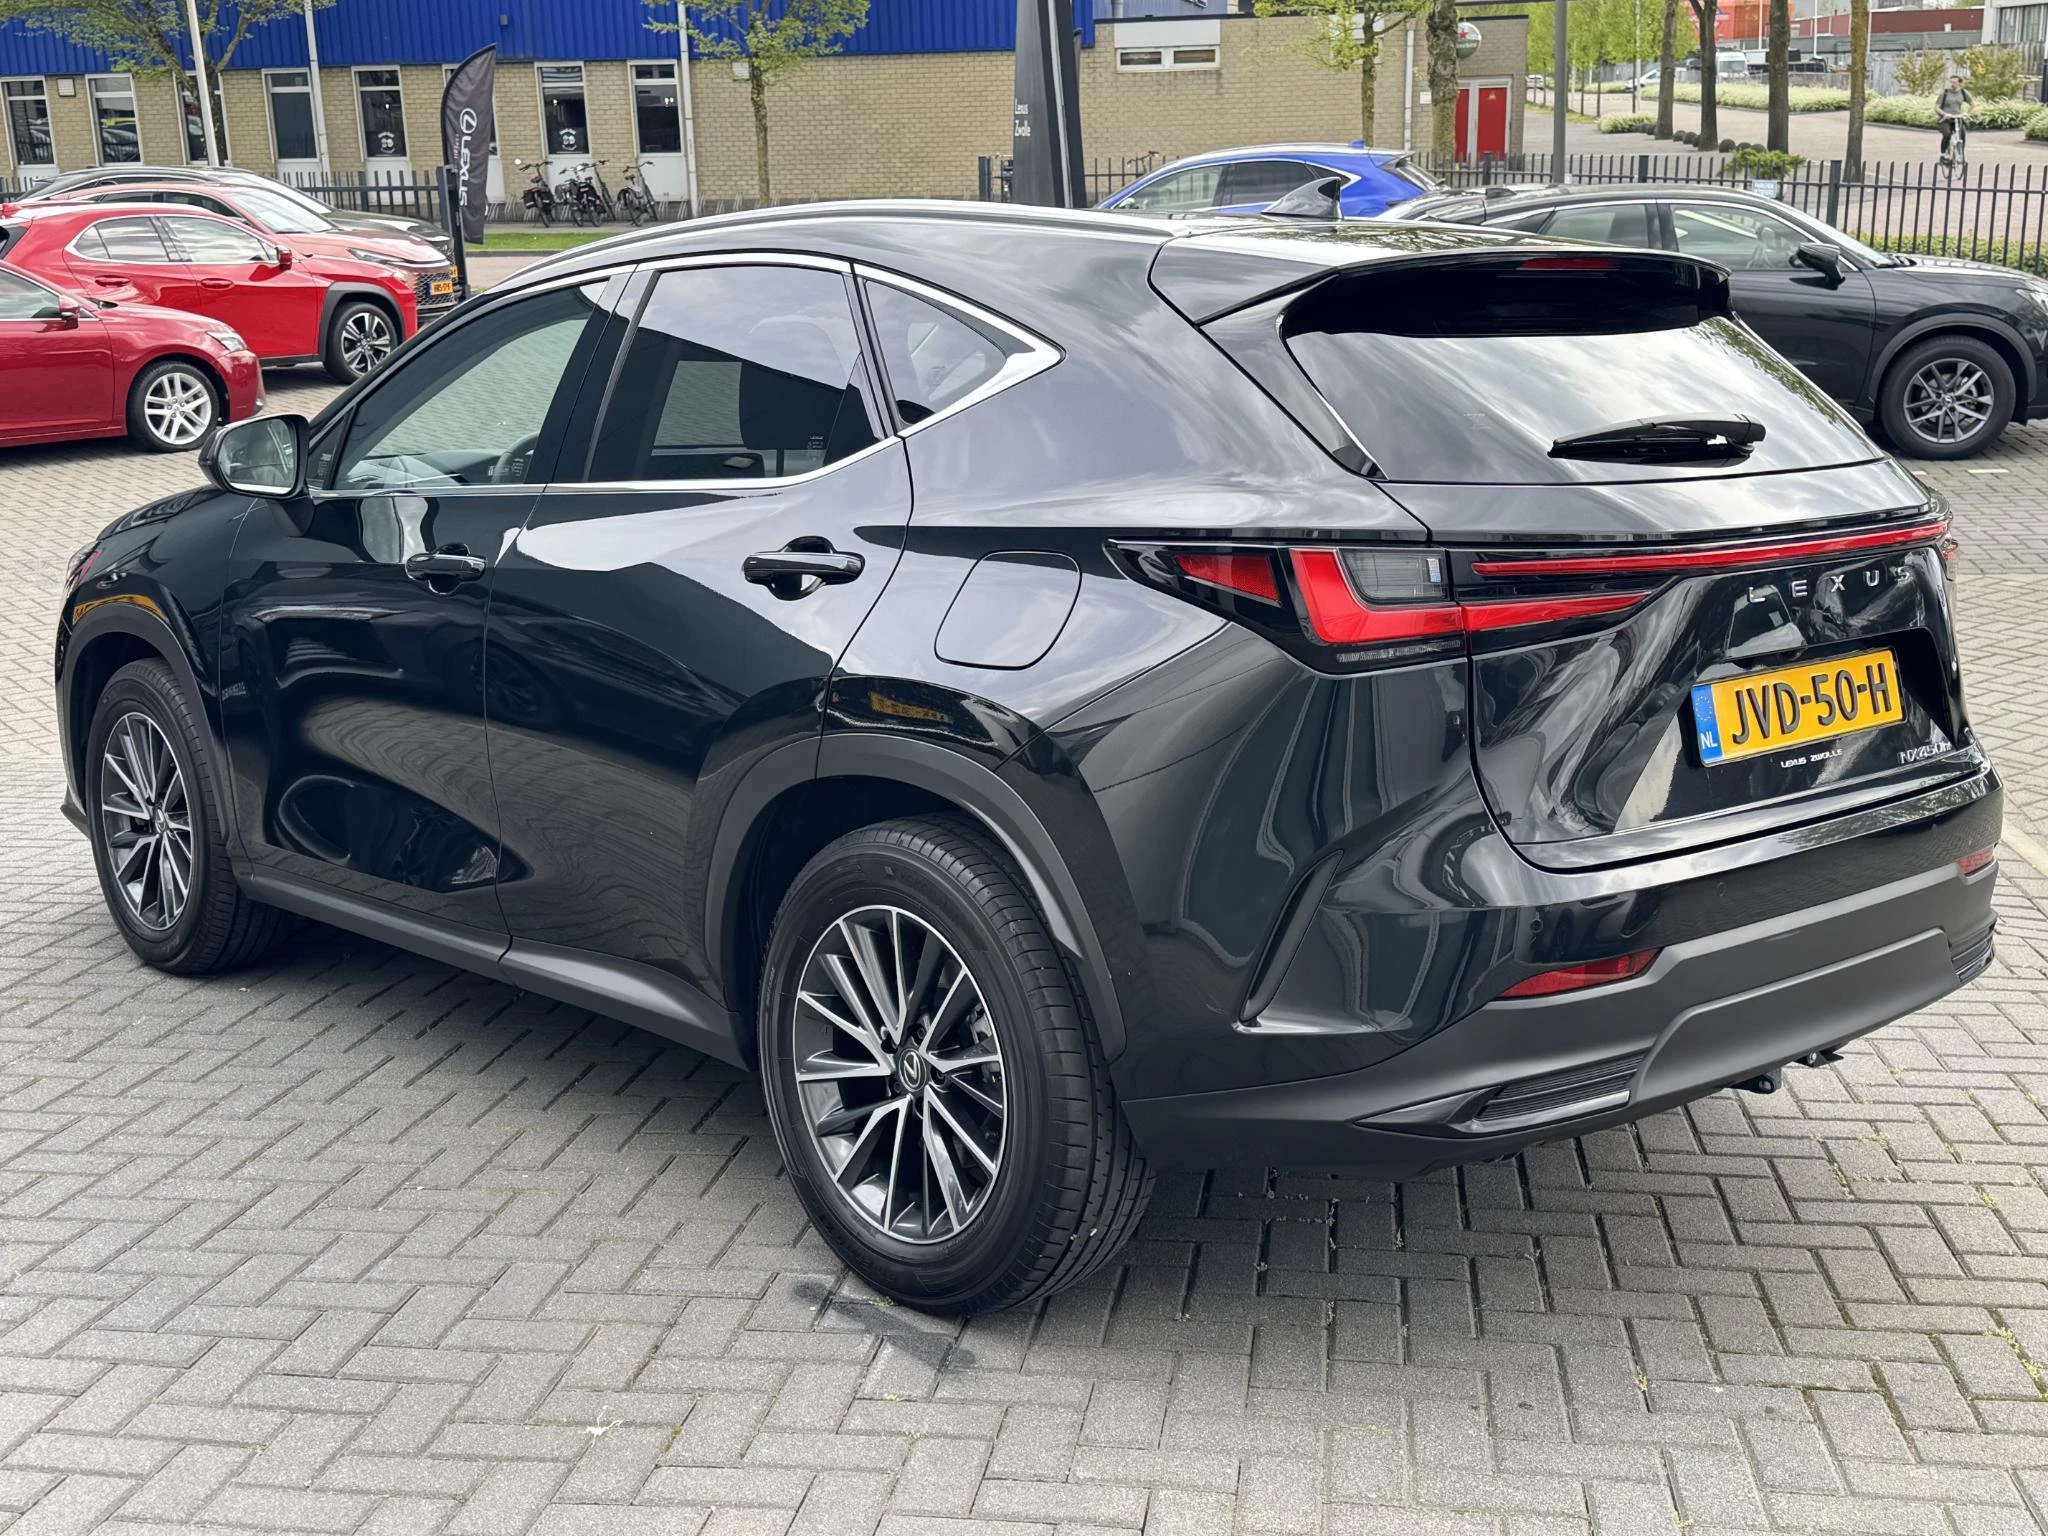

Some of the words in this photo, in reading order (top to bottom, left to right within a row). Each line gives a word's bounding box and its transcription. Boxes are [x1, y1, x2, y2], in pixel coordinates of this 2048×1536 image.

[1014, 98, 1029, 115] Lexus
[1014, 119, 1031, 137] Zwolle
[459, 135, 472, 207] LEXUS
[1748, 566, 1910, 603] LEXUS
[1731, 662, 1892, 745] JVD-50-H
[1700, 731, 1718, 750] NL
[1780, 756, 1807, 768] LEXUS
[1810, 748, 1843, 762] ZWOLLE
